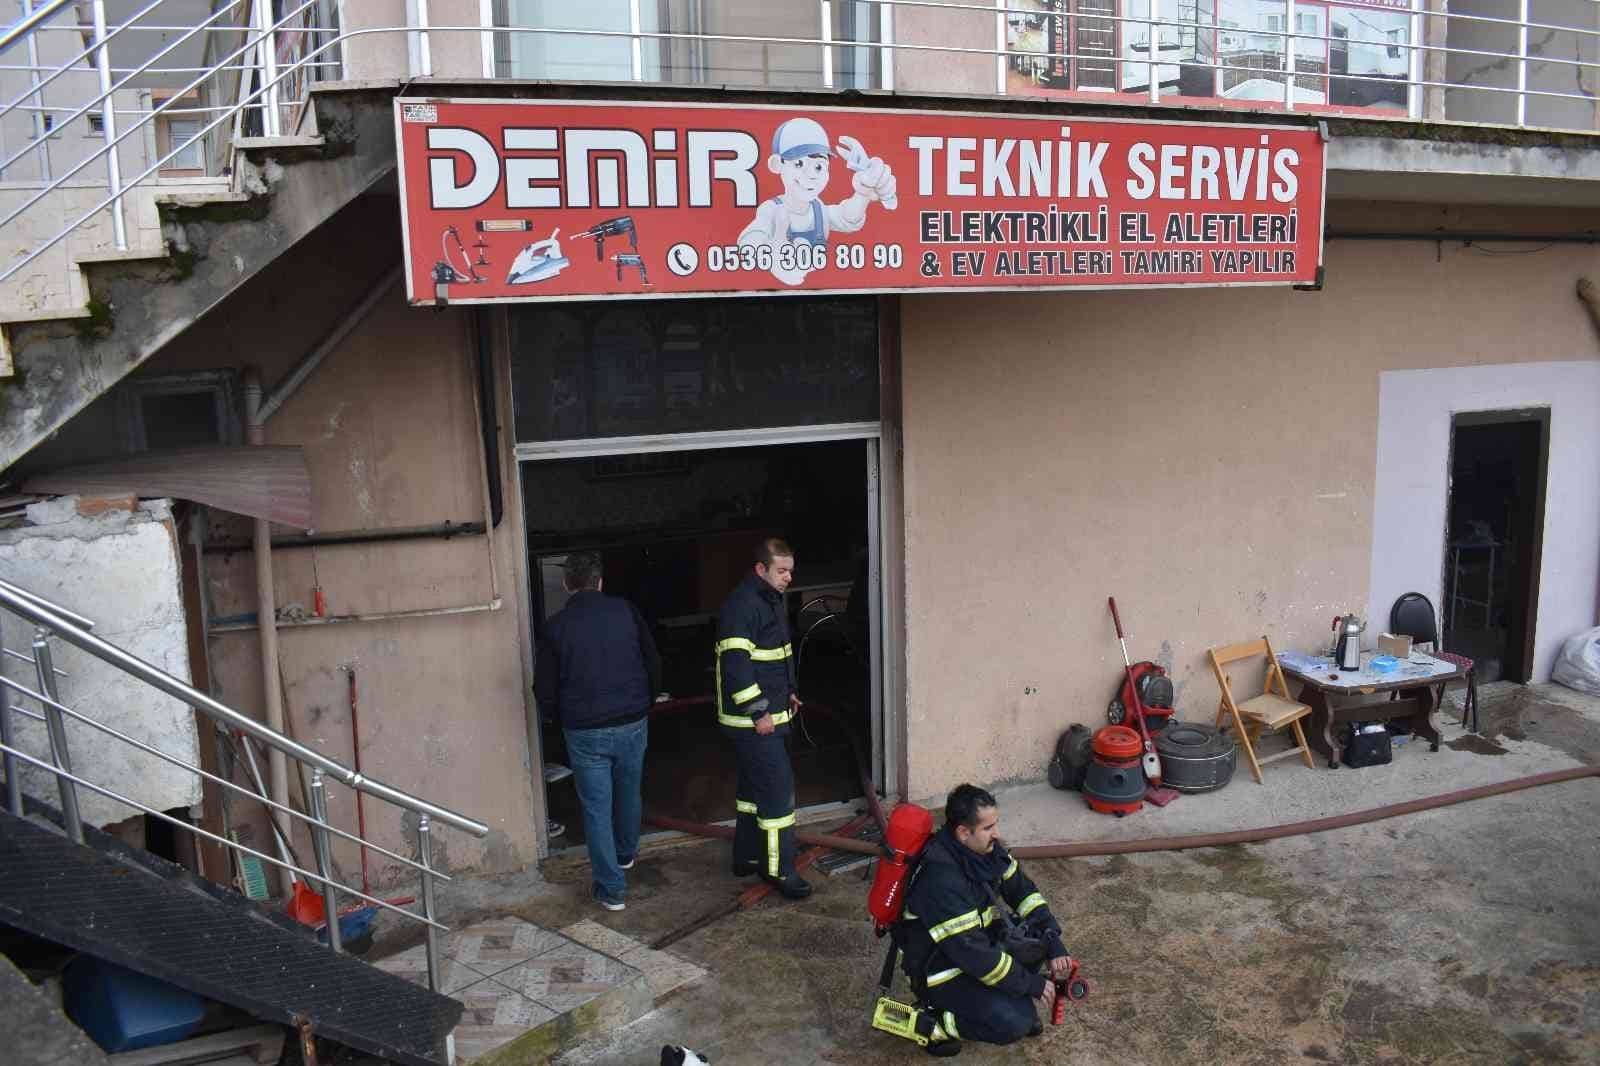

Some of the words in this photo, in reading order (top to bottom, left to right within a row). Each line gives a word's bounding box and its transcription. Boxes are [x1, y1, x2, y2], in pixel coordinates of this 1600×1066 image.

[908, 126, 1110, 198] TEKNİK
[1126, 134, 1299, 202] SERVİS
[919, 205, 1108, 244] ELEKTRİKLİ
[1119, 212, 1155, 243] EL
[1164, 208, 1297, 243] ALETLERİ
[707, 243, 773, 272] 0536
[779, 243, 828, 272] 306
[834, 243, 865, 271] 80
[872, 243, 904, 270] 90
[920, 250, 942, 277] &
[950, 251, 986, 276] EV
[1210, 248, 1297, 273] YAPILIR
